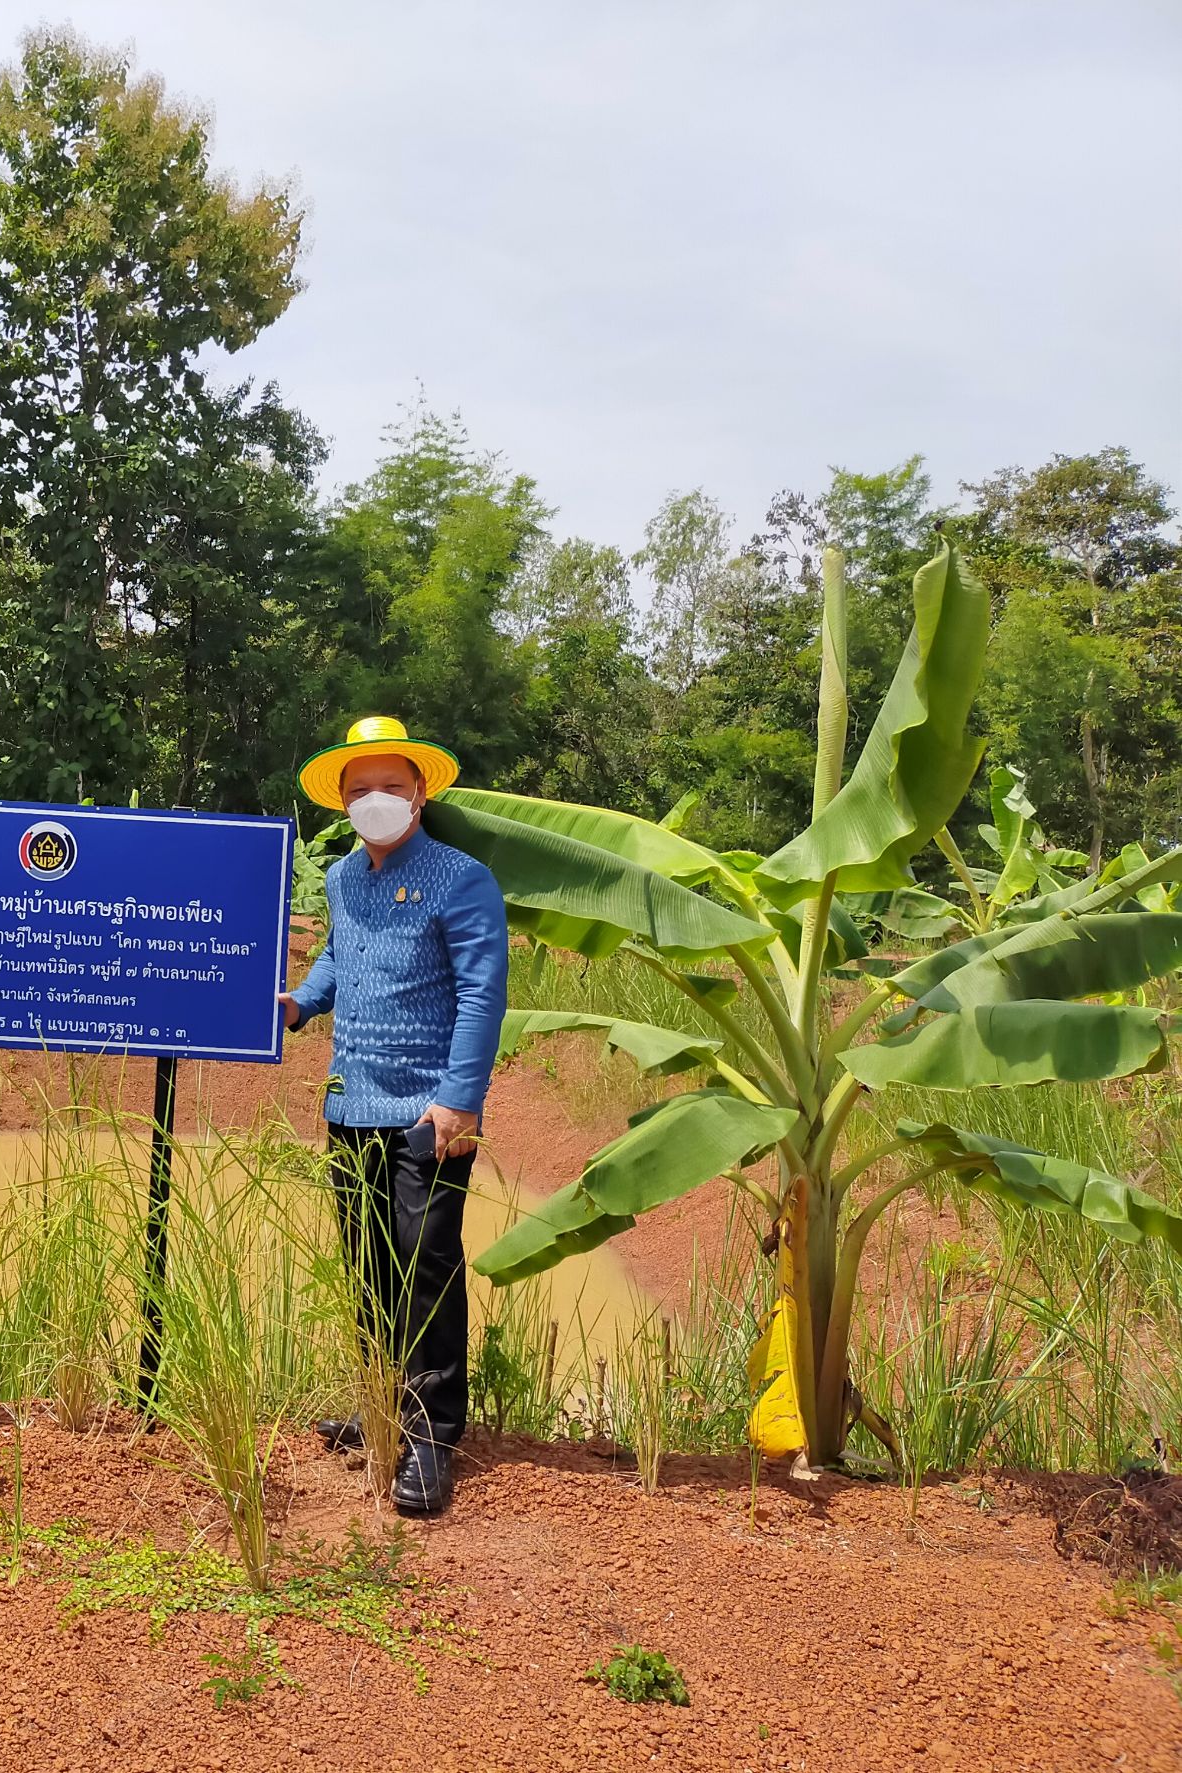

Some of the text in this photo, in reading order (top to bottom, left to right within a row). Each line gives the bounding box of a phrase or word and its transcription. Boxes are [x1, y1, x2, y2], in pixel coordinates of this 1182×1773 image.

[146, 937, 184, 952] หนอง
[90, 957, 121, 982] หมู่ที่
[125, 966, 138, 978] ๗
[142, 962, 225, 983] ตำบลนาแก้ว
[46, 987, 136, 1007] จังหวัดสกลนคร
[47, 1019, 144, 1040] แบบมาตรฐาน
